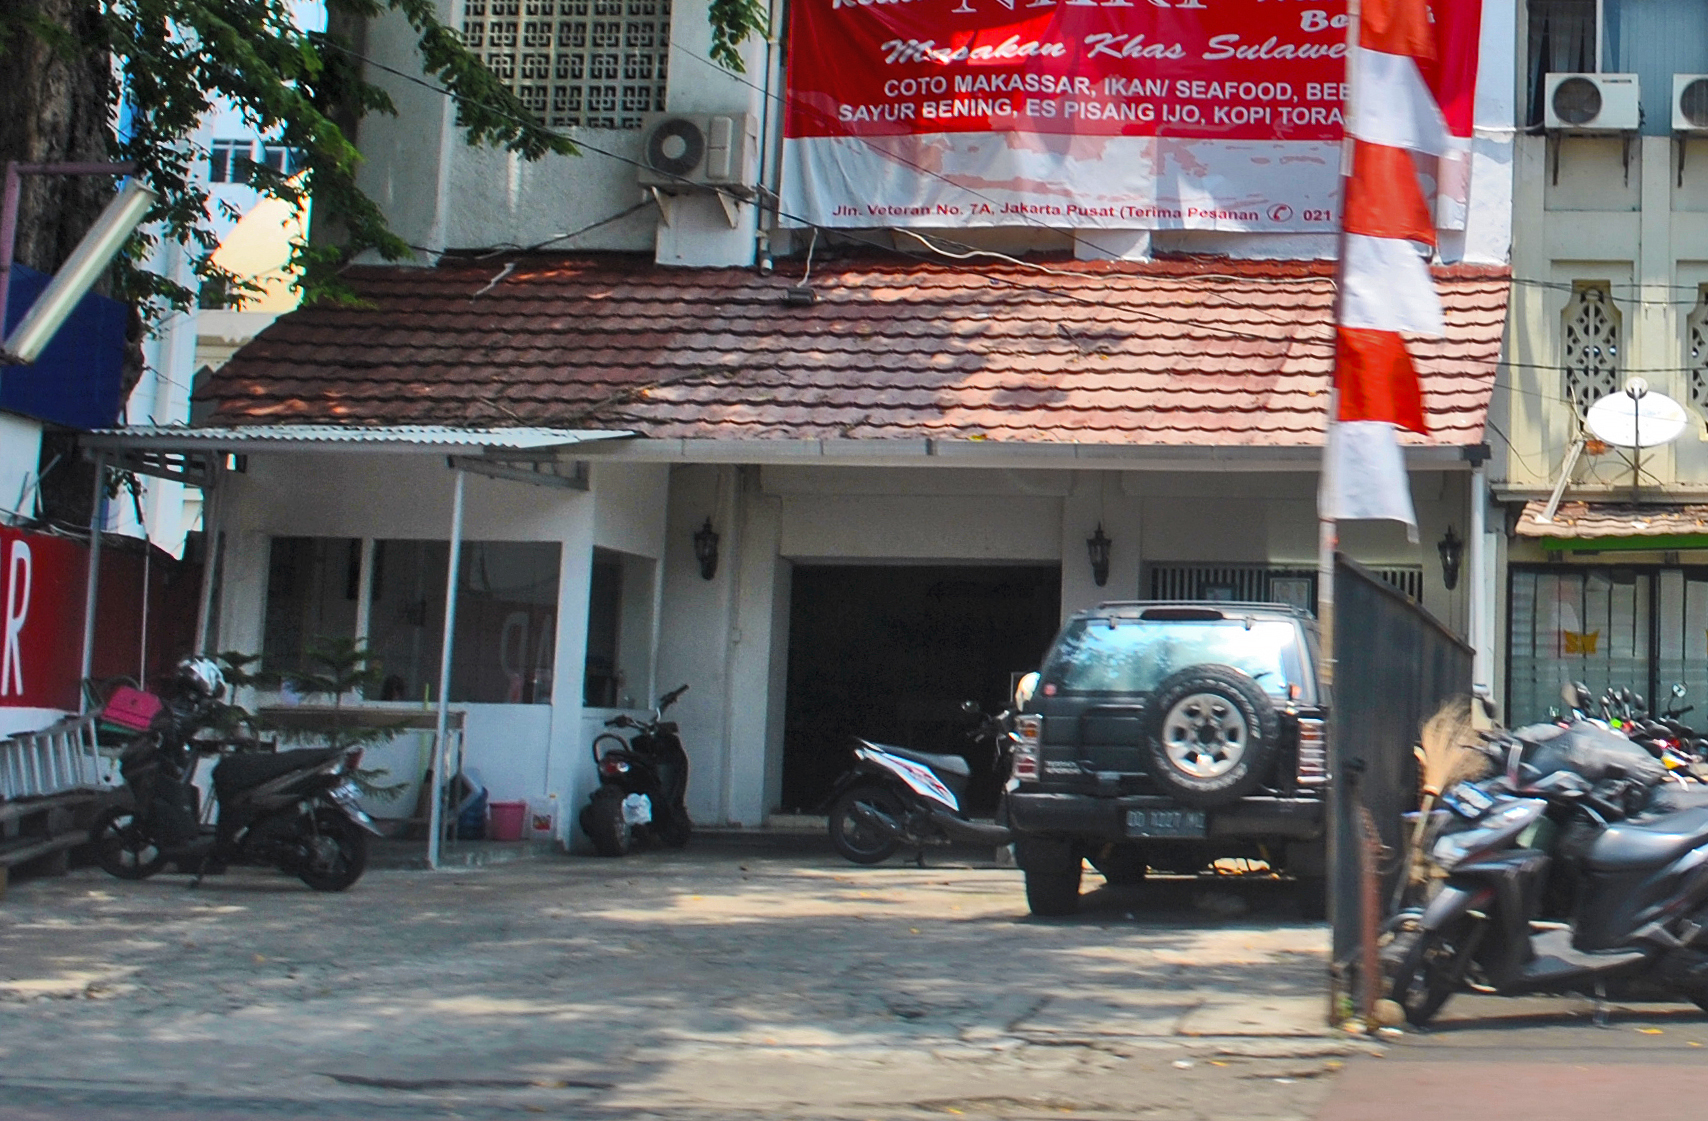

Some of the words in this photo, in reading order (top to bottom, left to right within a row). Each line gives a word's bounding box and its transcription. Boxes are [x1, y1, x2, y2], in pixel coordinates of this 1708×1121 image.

[880, 33, 1067, 65] Masakan
[1084, 32, 1187, 61] Khas
[884, 76, 947, 97] COTO
[954, 73, 1097, 97] MAKASSAR,
[1104, 77, 1170, 98] IKAN/
[1175, 79, 1299, 103] SEAFOOD,
[837, 102, 915, 122] SAYUR
[922, 97, 1018, 119] BENING,
[1026, 98, 1056, 117] ES
[1064, 99, 1155, 121] PISANG
[1162, 102, 1206, 125] IJO,
[1213, 105, 1271, 125] KOPI
[832, 205, 863, 217] Jln.
[867, 204, 930, 217] Veteran
[936, 204, 963, 216] No.
[970, 203, 995, 217] 7A,
[1000, 202, 1061, 216] Jakarta
[1066, 204, 1115, 218] Pusat
[1120, 205, 1182, 220] (Terima
[1187, 207, 1259, 221] Pesanan
[1303, 210, 1332, 221] 021
